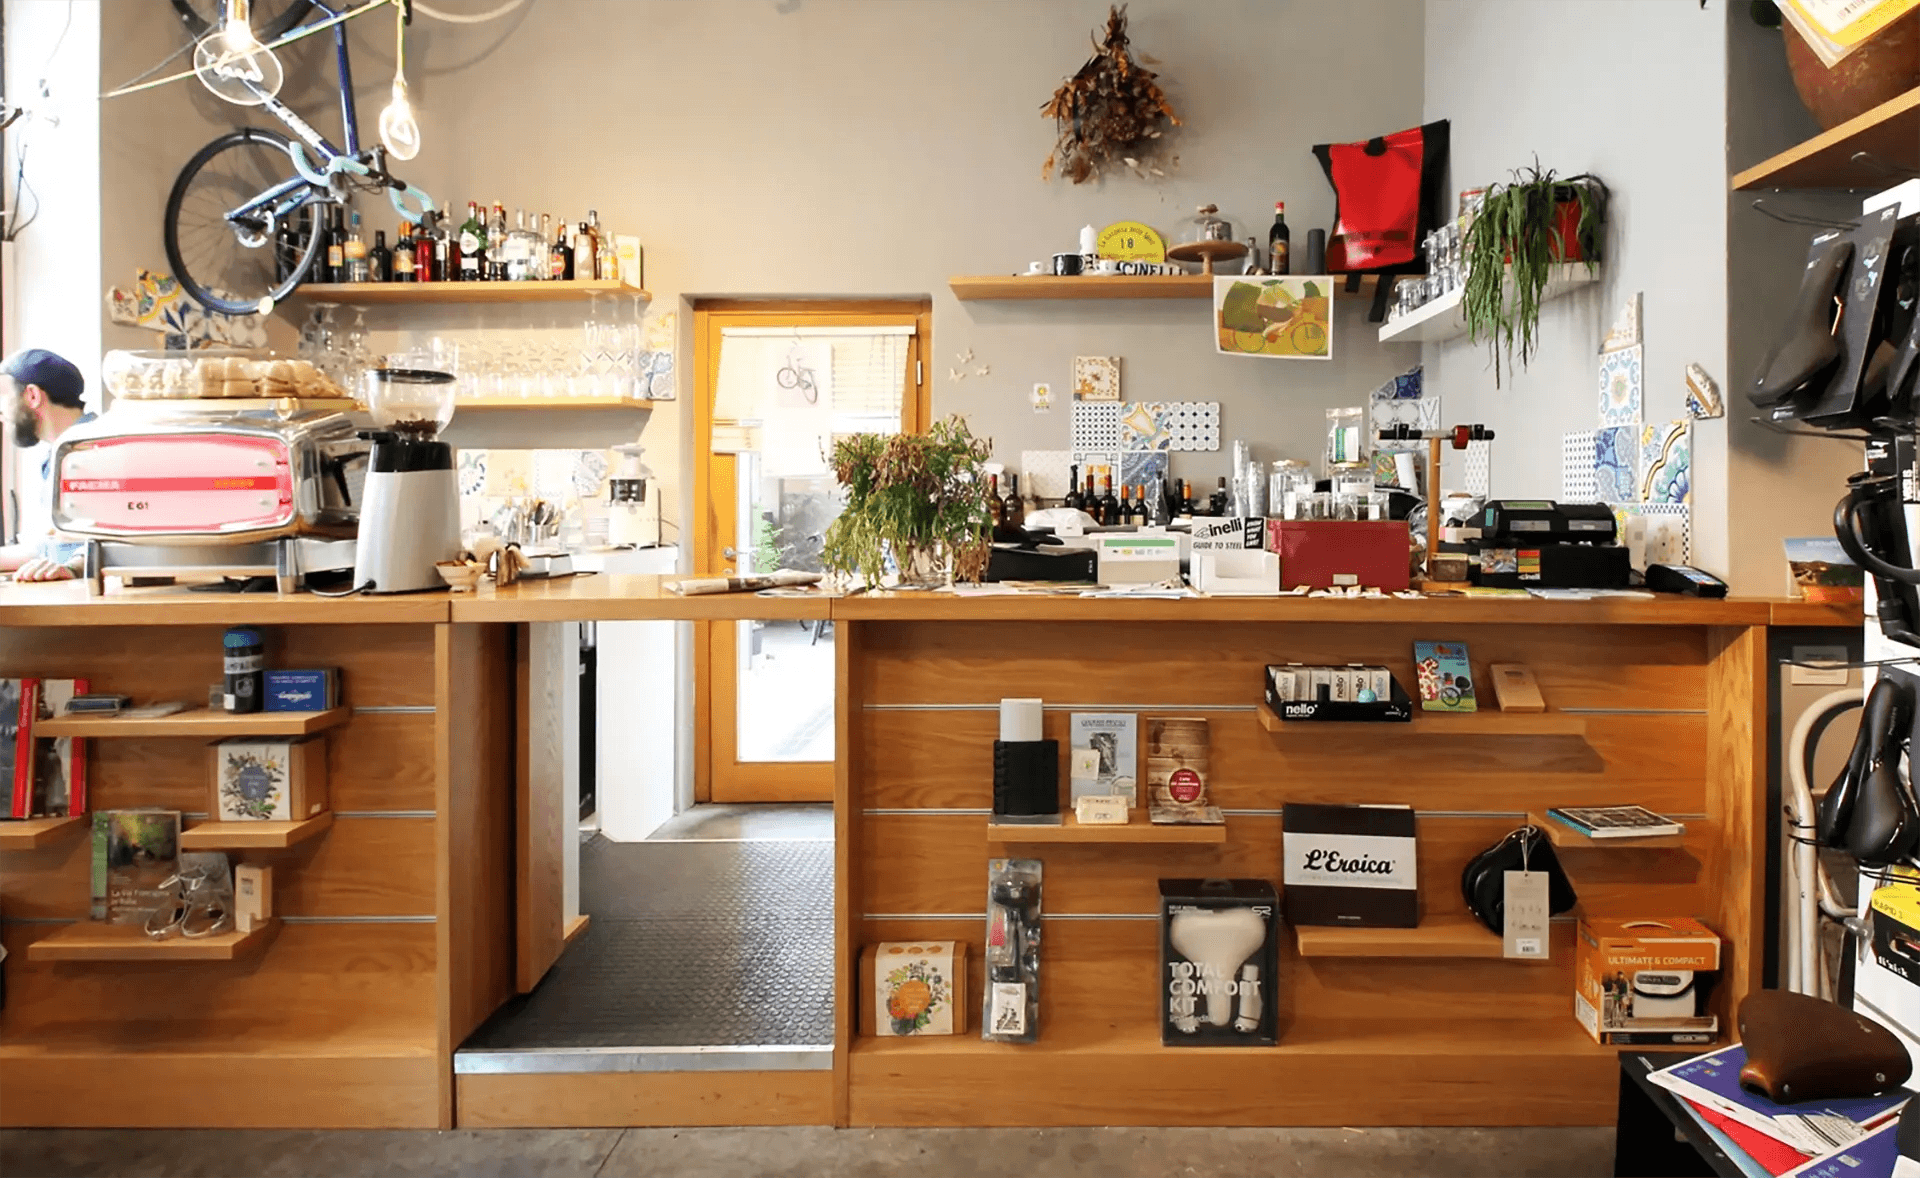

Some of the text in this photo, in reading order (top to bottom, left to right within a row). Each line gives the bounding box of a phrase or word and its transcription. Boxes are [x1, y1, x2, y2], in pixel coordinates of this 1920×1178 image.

[1120, 237, 1135, 249] 18
[1192, 541, 1243, 550] GUIDE TO STEEL
[1285, 703, 1317, 715] nello
[1302, 848, 1394, 875] L'Eroica
[1608, 956, 1652, 966] ULTIMATE
[1662, 956, 1706, 966] COMPACT
[1168, 961, 1226, 978] TOTAL
[1168, 979, 1262, 996] COMFORT
[1169, 996, 1198, 1013] KIT
